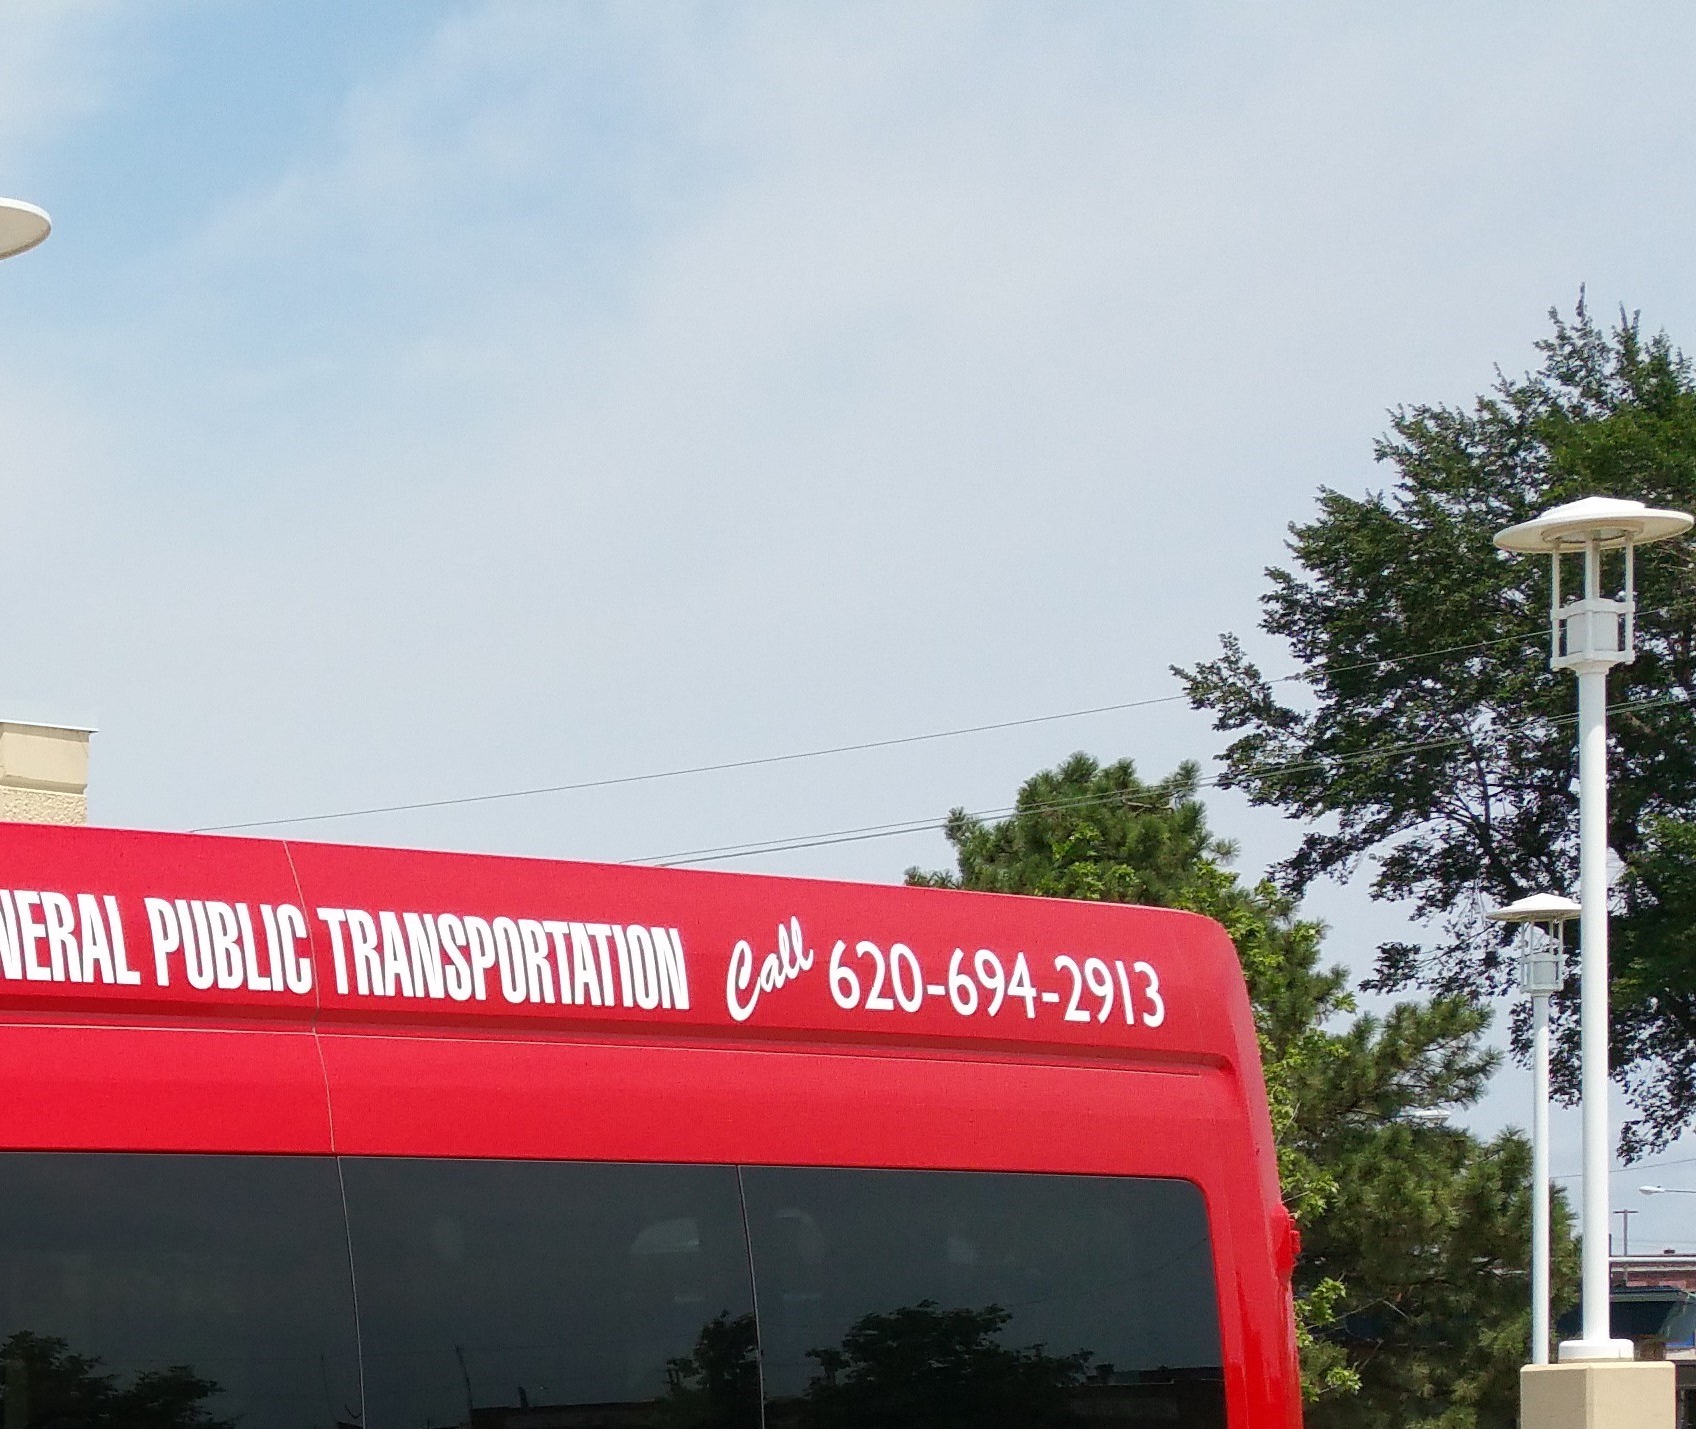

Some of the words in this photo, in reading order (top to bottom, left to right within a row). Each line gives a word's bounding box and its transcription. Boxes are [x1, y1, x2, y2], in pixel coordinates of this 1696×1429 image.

[144, 896, 313, 994] PUBLIC
[317, 907, 690, 1010] TRANSPORTATION
[726, 915, 814, 1022] Call
[829, 939, 1165, 1027] 620-694-2913
